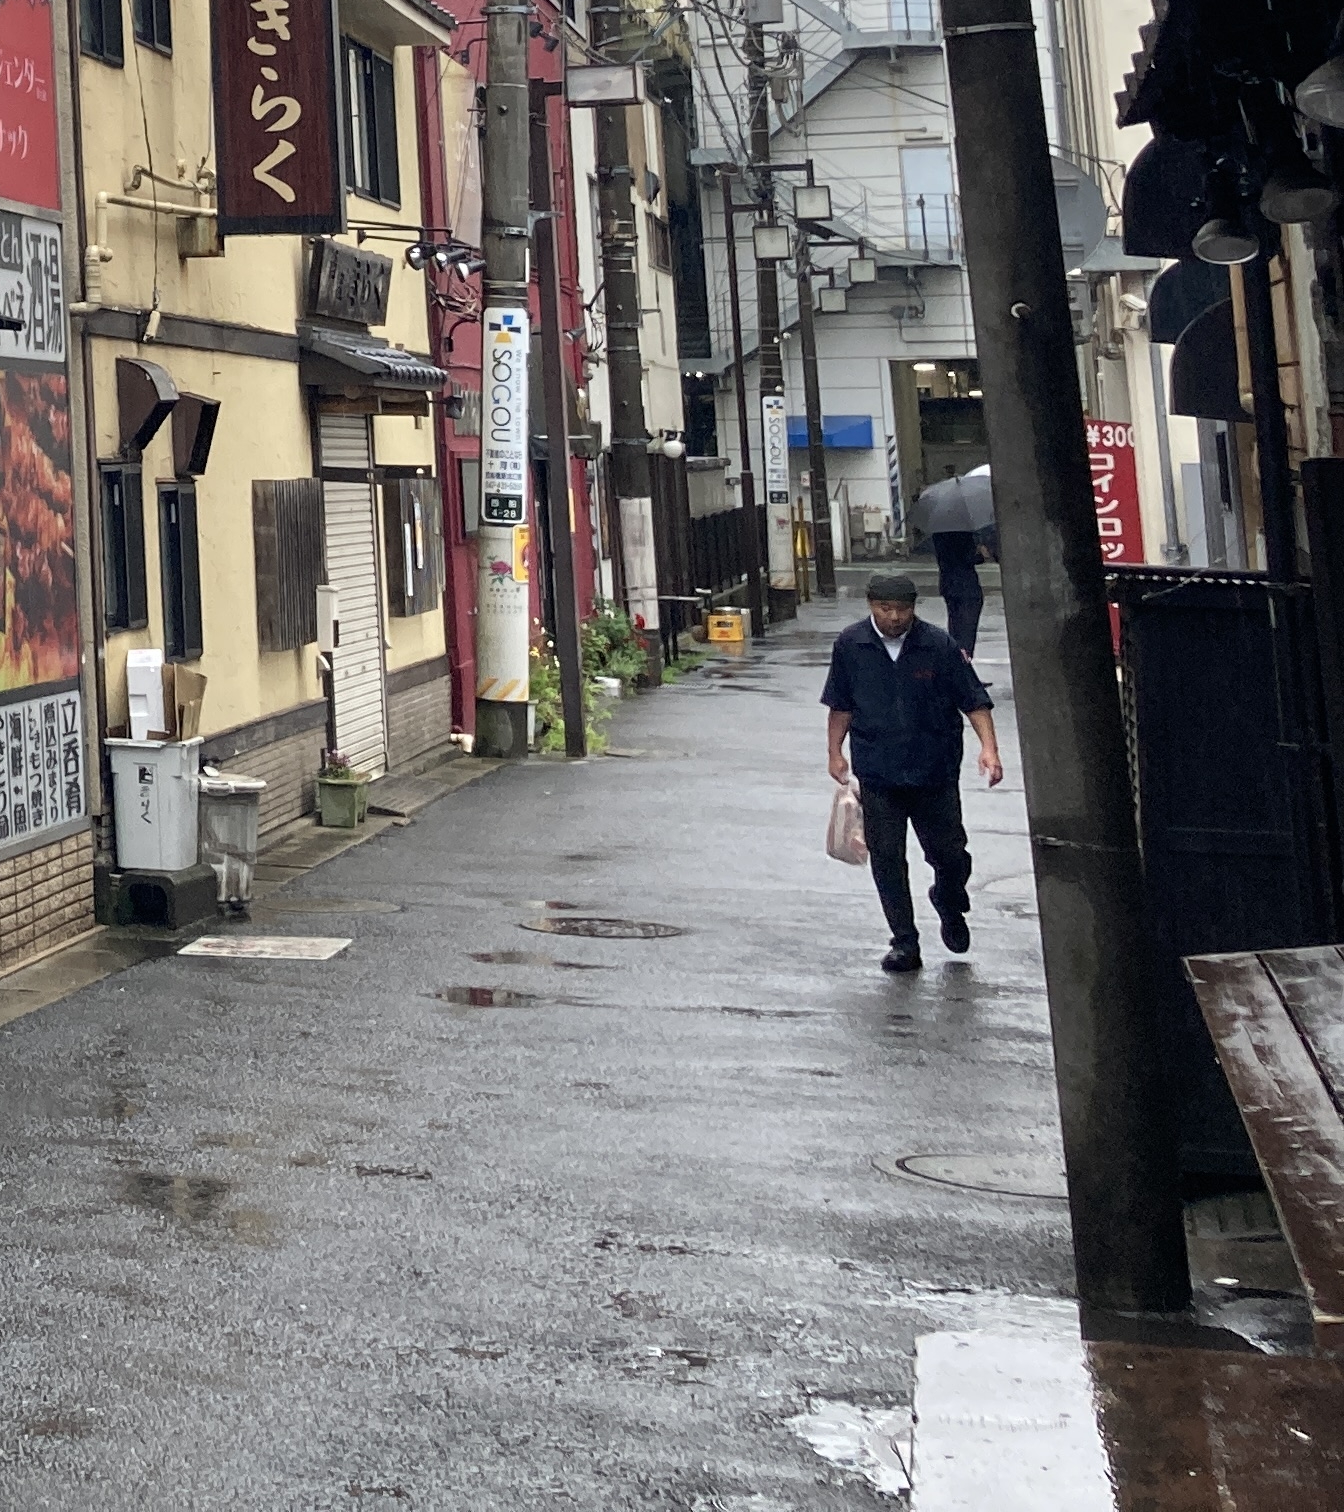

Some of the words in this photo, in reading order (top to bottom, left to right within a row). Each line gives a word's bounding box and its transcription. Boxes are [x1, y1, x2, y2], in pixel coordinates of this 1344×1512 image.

[491, 348, 512, 443] SOGOU
[1089, 453, 1125, 559] コインロッ
